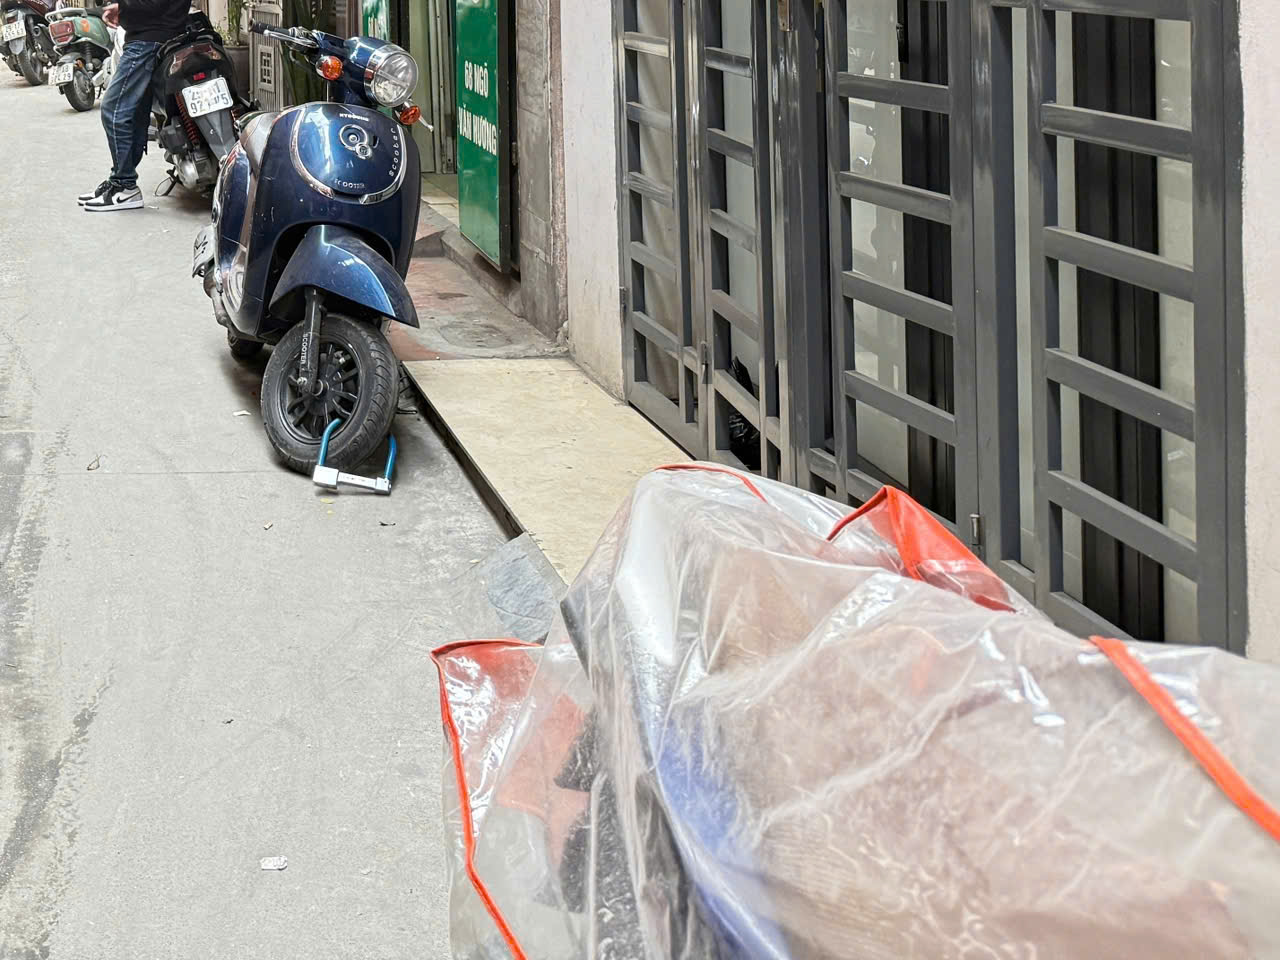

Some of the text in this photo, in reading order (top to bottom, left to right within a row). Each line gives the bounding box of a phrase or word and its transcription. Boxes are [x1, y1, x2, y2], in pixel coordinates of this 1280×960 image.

[464, 60, 488, 99] 68 NGÕ
[458, 102, 497, 156] VĂN HƯƠNG
[300, 333, 309, 365] SCOOTER
